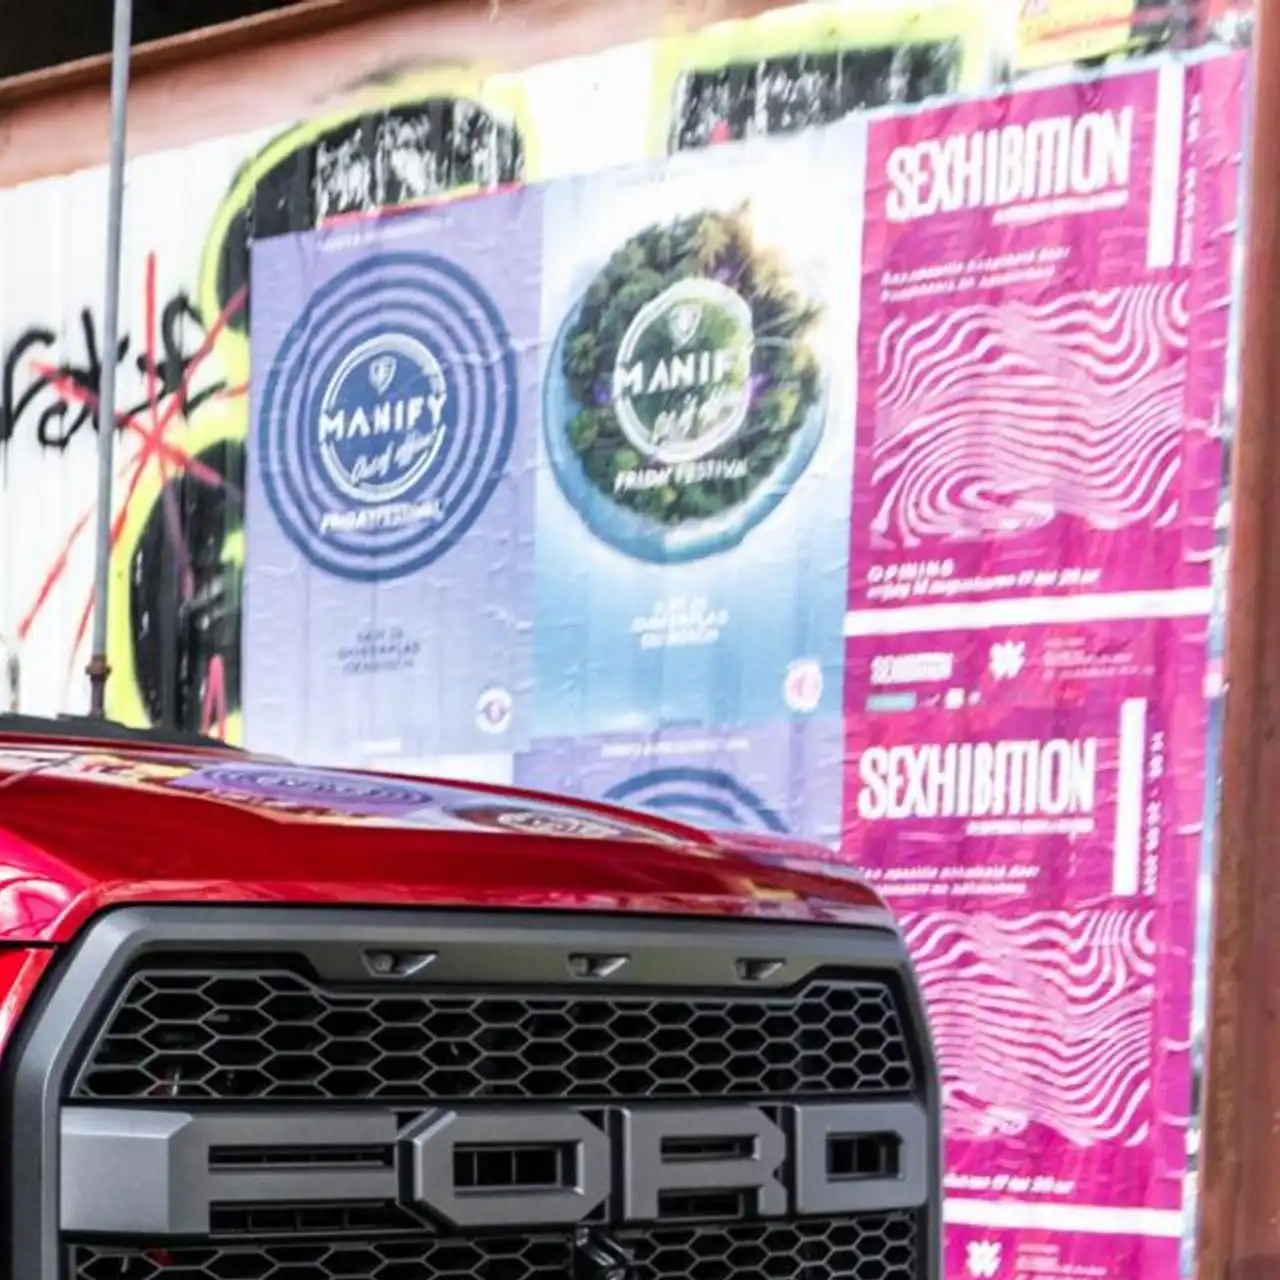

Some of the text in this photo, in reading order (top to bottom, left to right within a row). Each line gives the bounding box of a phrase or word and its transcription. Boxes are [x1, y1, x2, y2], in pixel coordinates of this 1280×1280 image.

[886, 106, 1133, 223] SEXHIBITION
[858, 737, 1097, 820] SEXHIBITION
[60, 1103, 927, 1235] FORD
